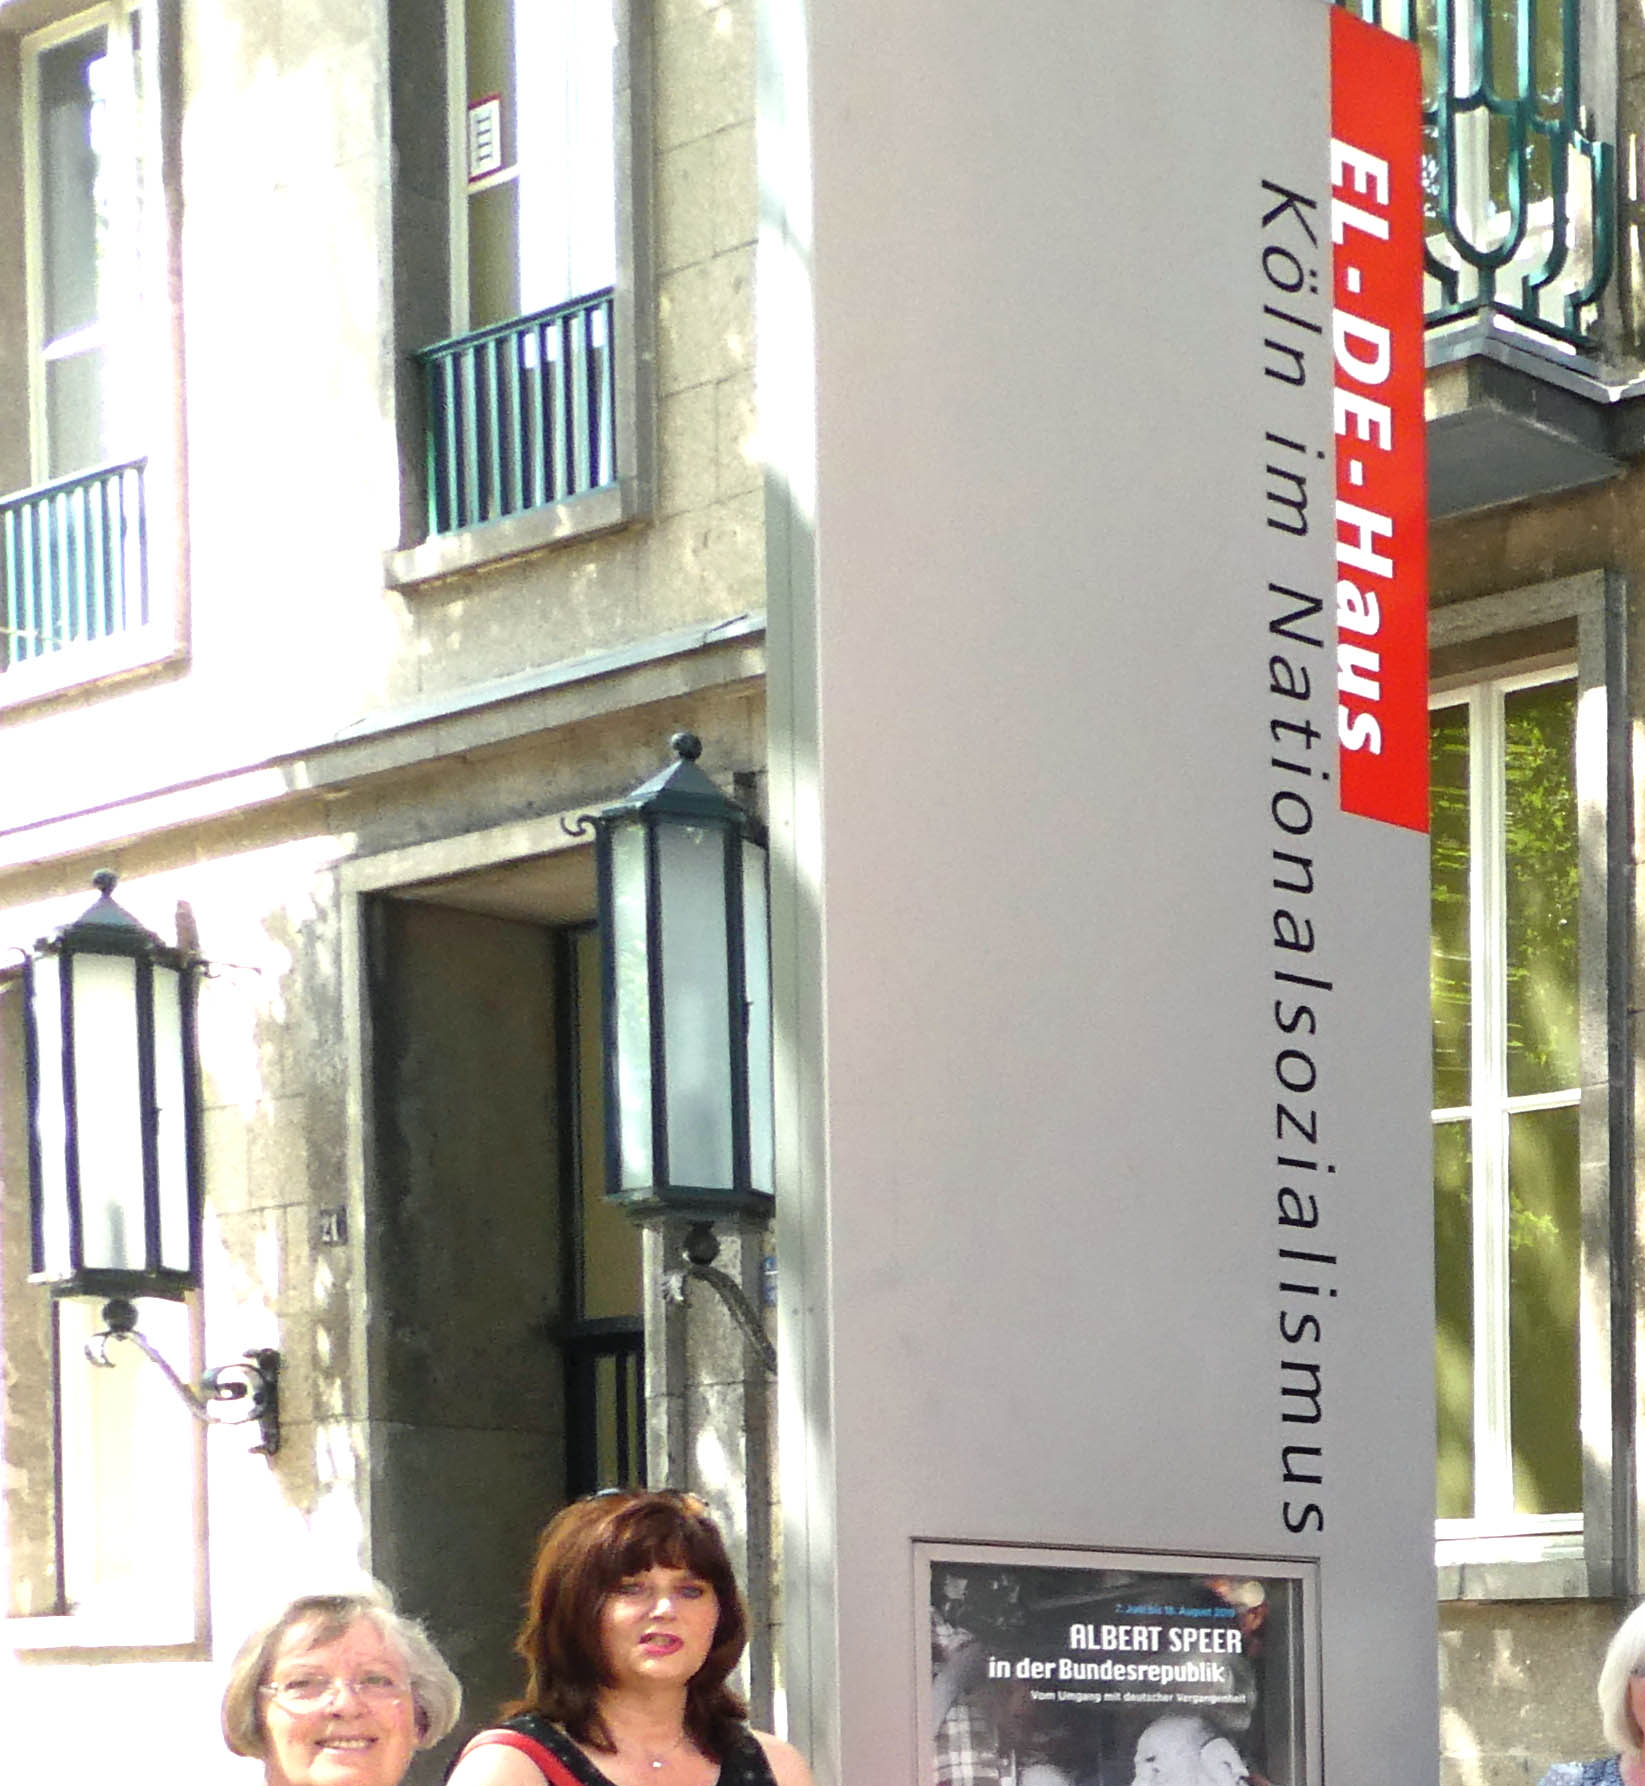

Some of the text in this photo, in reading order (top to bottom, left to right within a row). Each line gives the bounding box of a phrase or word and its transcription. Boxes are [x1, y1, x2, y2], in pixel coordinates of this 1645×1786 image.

[1330, 137, 1393, 757] EL-DE-Haus
[1261, 178, 1339, 1535] Köln im Nationalsozialismus
[1069, 1623, 1243, 1654] ALBERT SPEER
[988, 1656, 1226, 1685] in der Bundesrepublik
[1057, 1690, 1101, 1704] Umgang
[1123, 1691, 1173, 1702] deutscher
[1176, 1693, 1247, 1704] Vergangenheit
